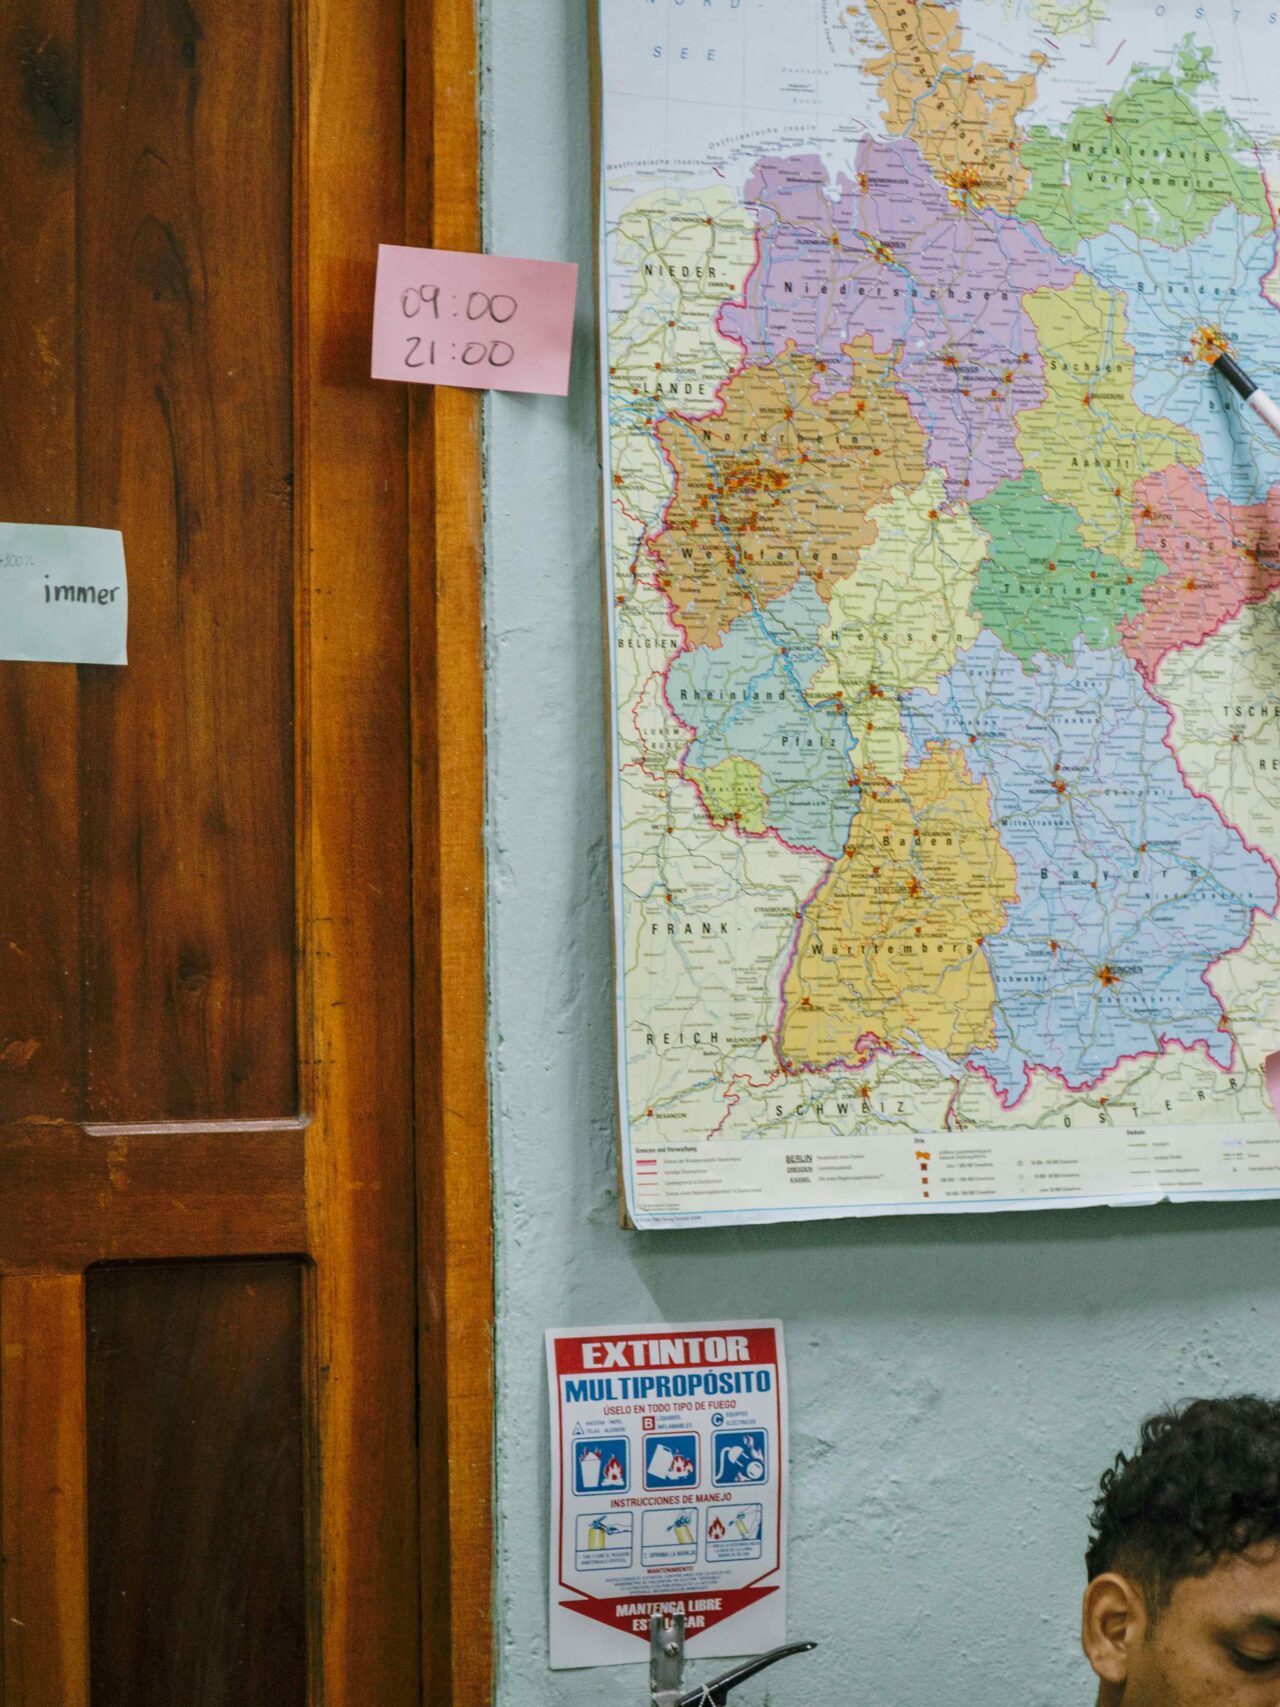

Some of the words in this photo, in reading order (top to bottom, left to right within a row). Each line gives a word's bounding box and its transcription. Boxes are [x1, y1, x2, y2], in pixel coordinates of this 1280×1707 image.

[652, 46, 716, 61] SEE
[402, 284, 518, 323] 09:00
[404, 337, 515, 367] 21:00
[643, 382, 706, 395] LANDE
[44, 574, 120, 605] immer
[617, 638, 678, 649] BELGIEN
[831, 630, 963, 643] Hessen
[680, 689, 796, 701] Rheinland-
[782, 735, 836, 748] Pfalz
[1041, 867, 1199, 881] Bayern
[652, 922, 742, 935] FRANK-
[812, 943, 973, 956] Württemberg
[646, 1032, 718, 1045] REICH
[775, 1101, 905, 1117] SCHWEIZ
[581, 1335, 750, 1369] EXTINTOR
[565, 1369, 771, 1403] MULTIPROPÓSITO
[603, 1403, 631, 1415] ÚSELO
[634, 1404, 645, 1414] EN
[648, 1403, 671, 1413] TODO
[673, 1402, 692, 1411] TIPO
[695, 1401, 706, 1411] DE
[708, 1400, 736, 1410] FUEGO
[644, 1417, 654, 1430] B
[610, 1496, 680, 1509] INSTRUCCIONES
[682, 1495, 693, 1505] DE
[695, 1492, 732, 1503] MANEJO
[616, 1601, 685, 1617] MANTENGA
[688, 1598, 722, 1612] LIBRE
